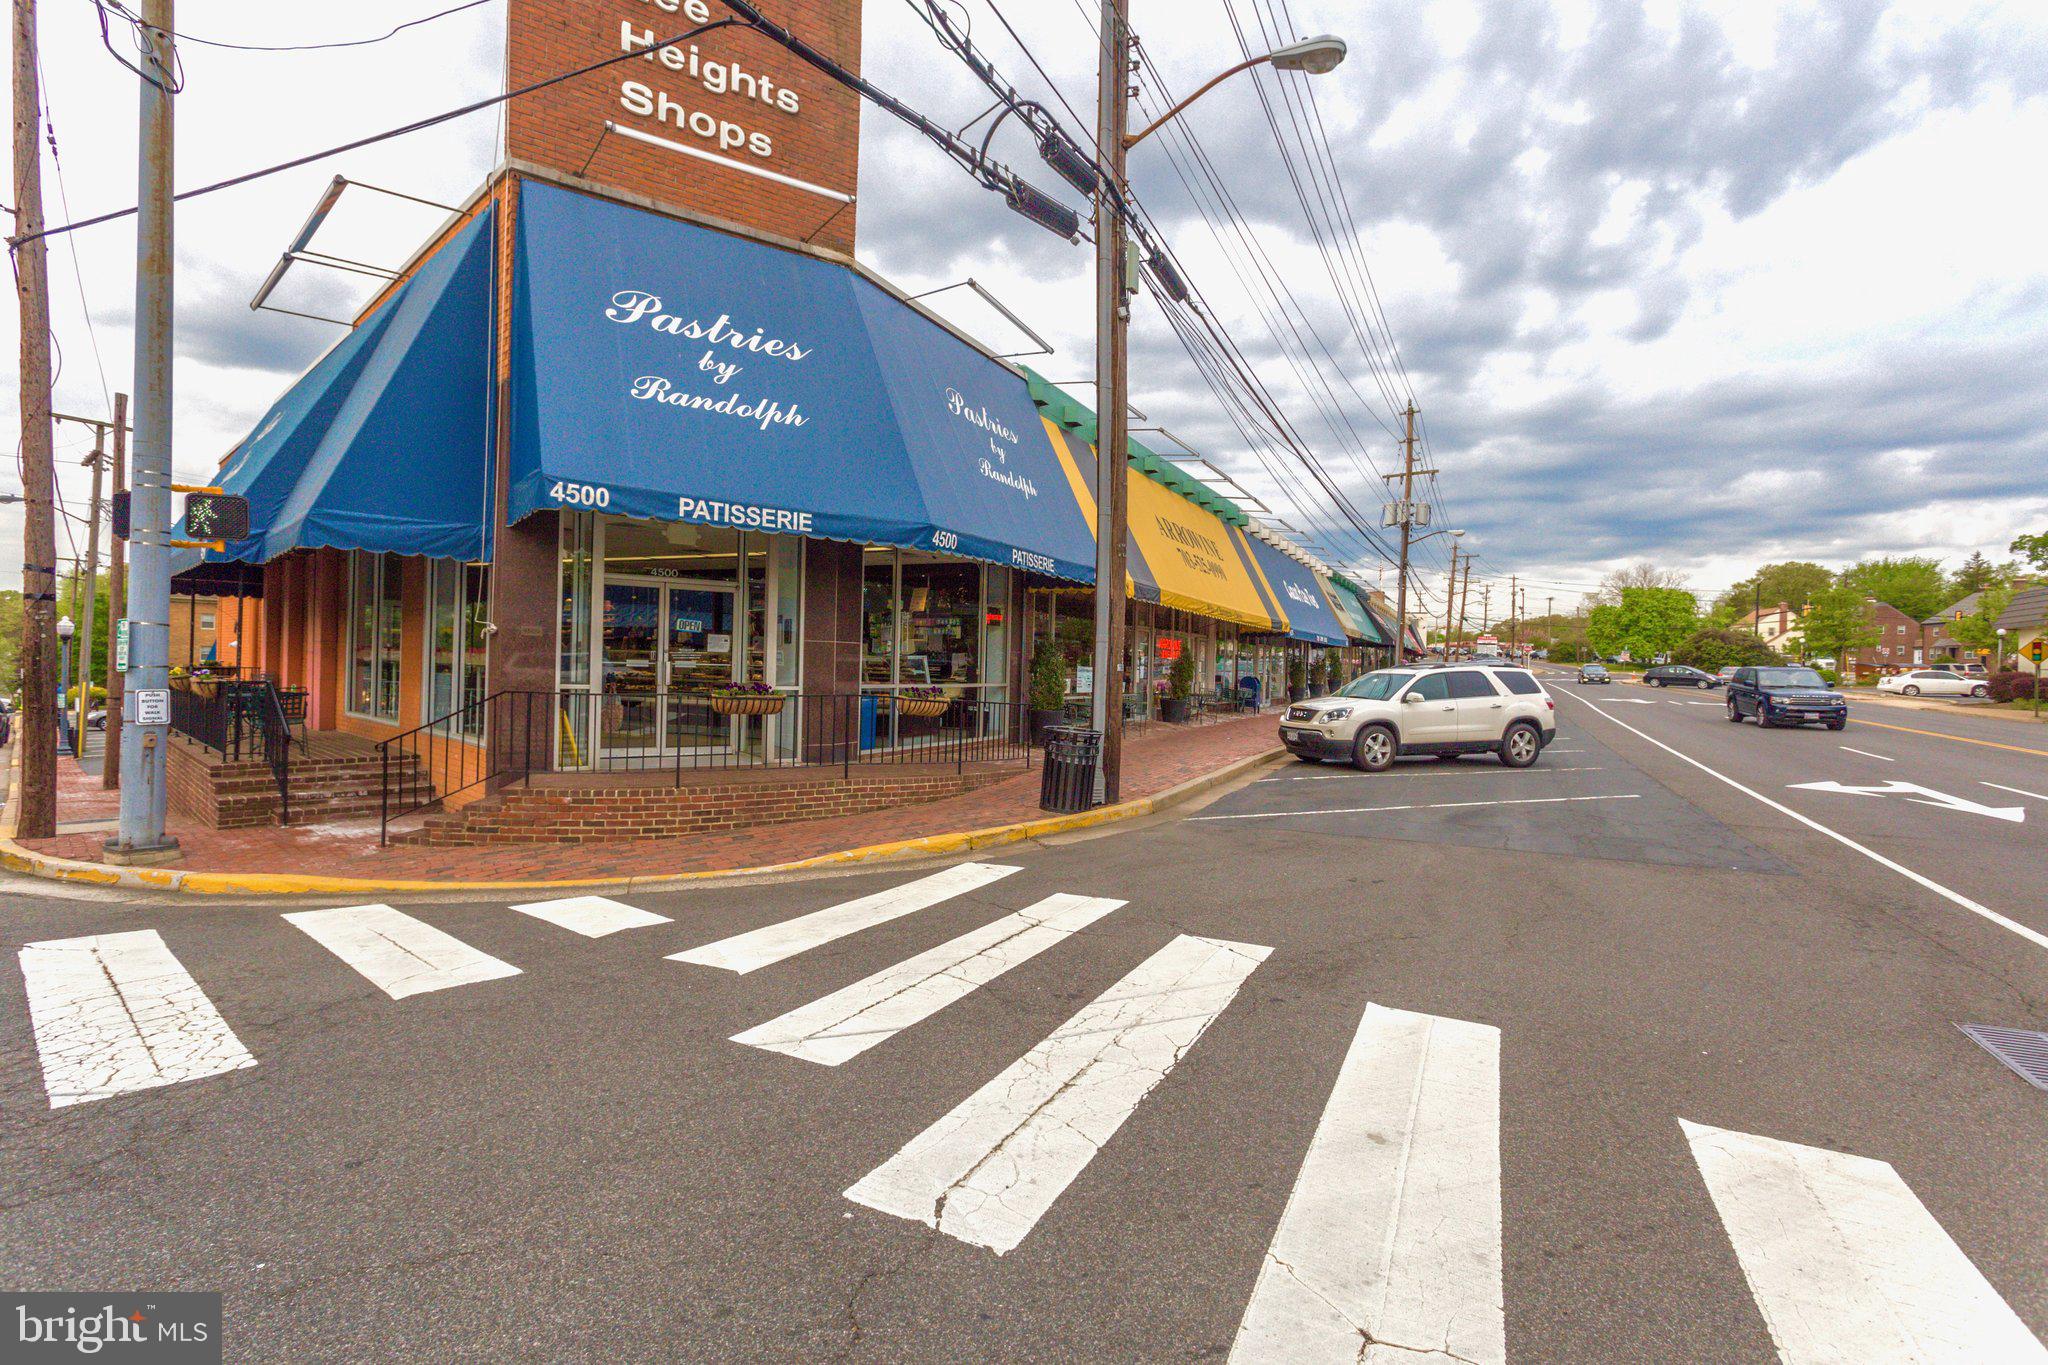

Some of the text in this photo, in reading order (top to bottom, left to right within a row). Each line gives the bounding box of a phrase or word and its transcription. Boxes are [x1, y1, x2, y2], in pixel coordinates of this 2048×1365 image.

[620, 20, 800, 115] Heights
[620, 80, 772, 158] Shops
[605, 290, 812, 361] Pastries
[697, 350, 743, 385] by
[630, 375, 810, 430] Randolph
[945, 387, 1019, 445] Pastries
[990, 438, 1007, 464] by
[978, 457, 1038, 500] Randolph
[549, 481, 813, 532] 4500 PATISSERIE
[932, 530, 1055, 572] 4500 PATISSERIE
[1153, 511, 1224, 561] ARROWINE
[650, 567, 679, 578] 4500
[679, 620, 701, 631] OPEN
